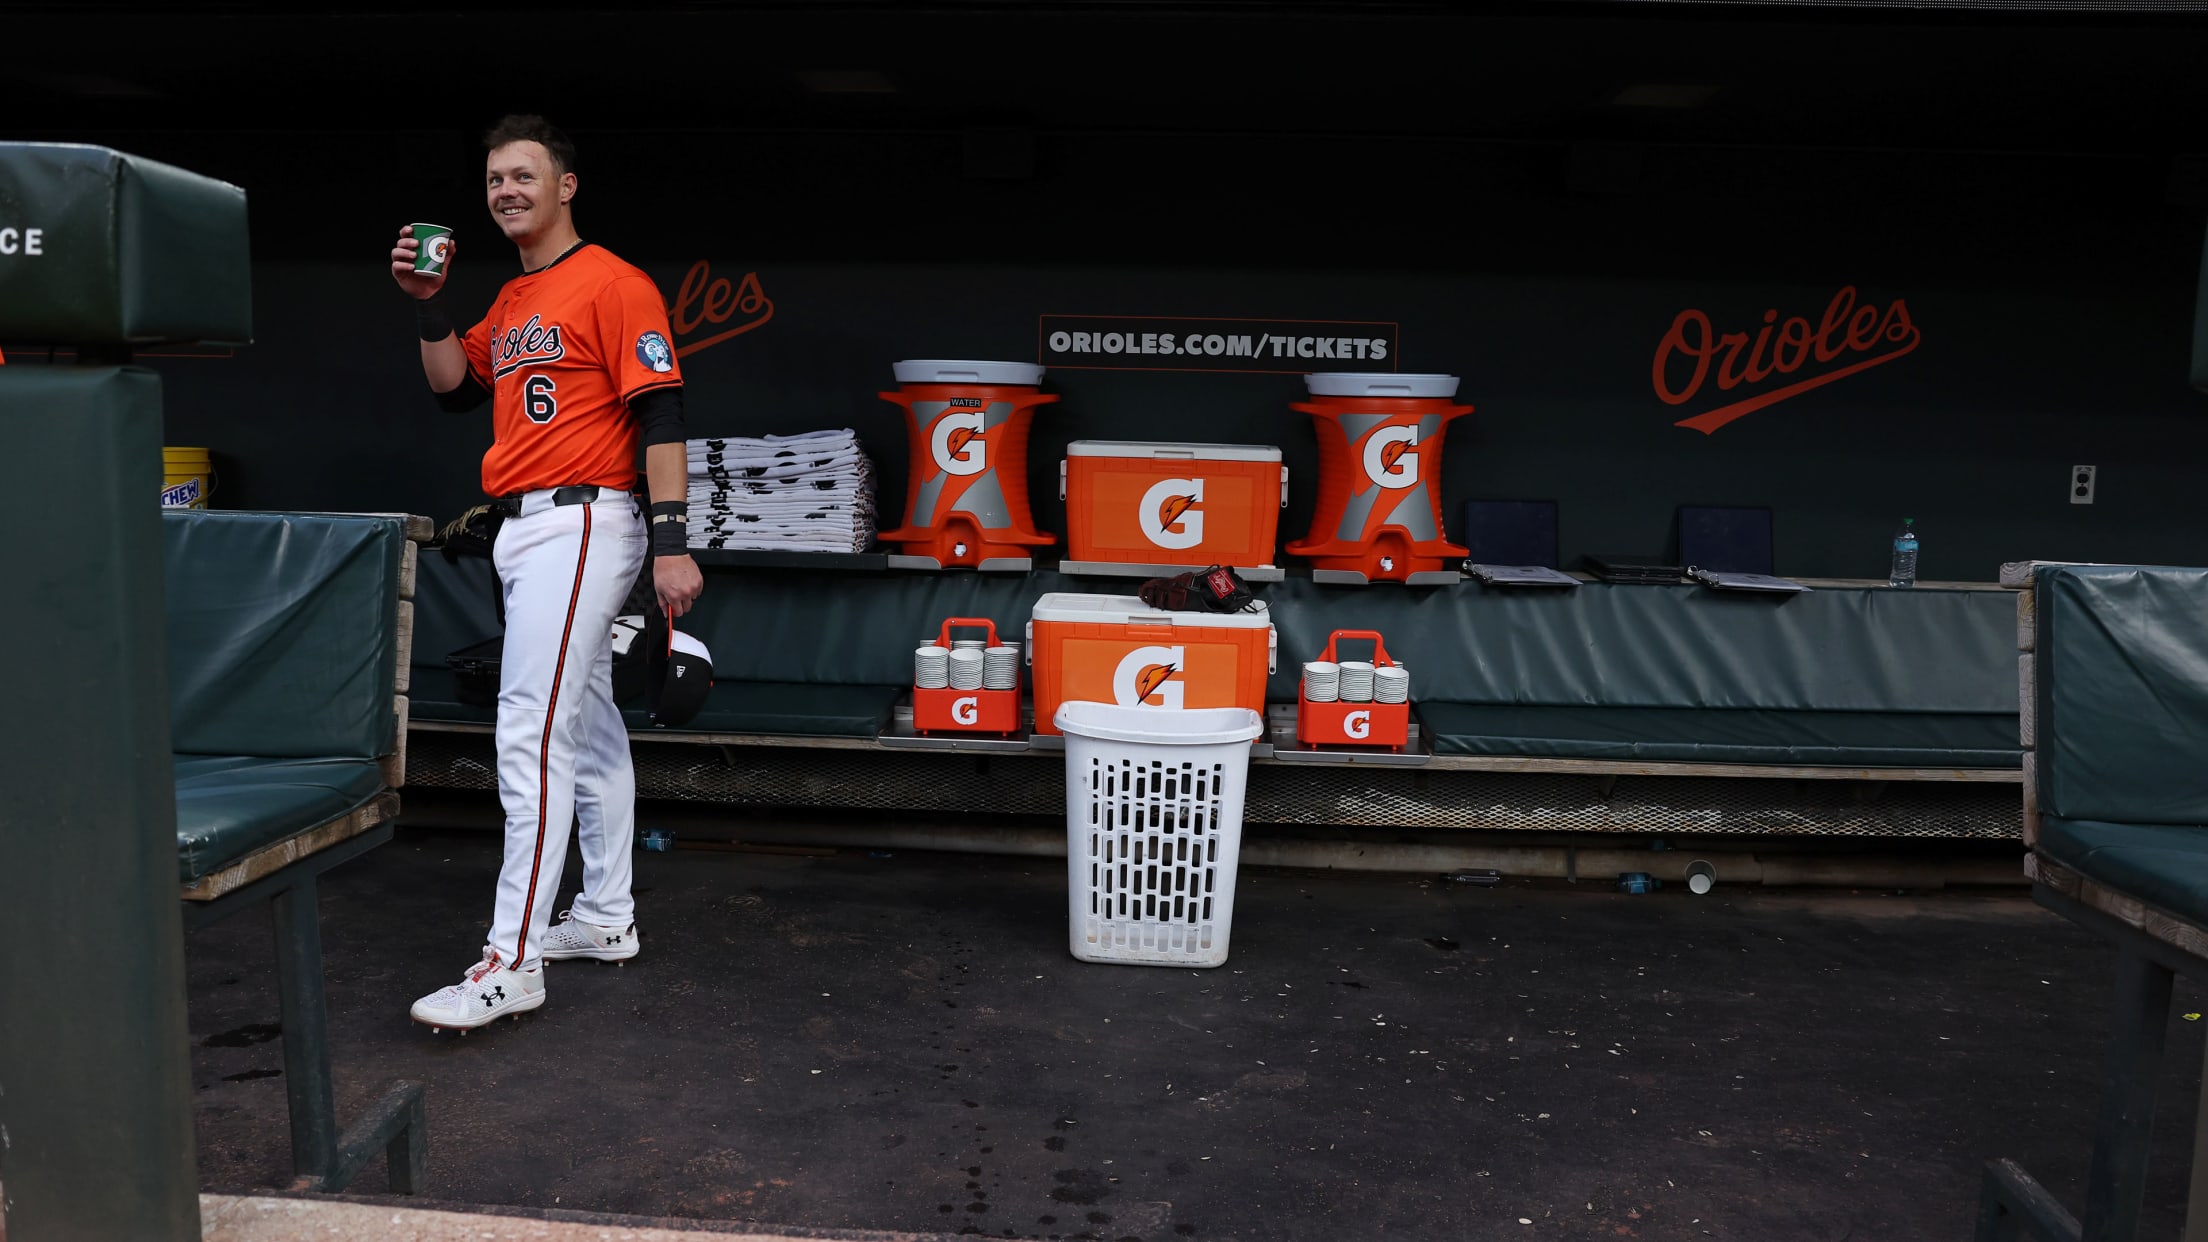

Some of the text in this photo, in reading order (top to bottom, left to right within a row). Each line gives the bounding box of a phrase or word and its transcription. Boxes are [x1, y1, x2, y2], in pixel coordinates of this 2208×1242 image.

[1049, 331, 1388, 360] ORIOLES.COM/TICKETS
[1652, 285, 1920, 428] Orioles
[524, 375, 557, 424] 6
[951, 398, 981, 407] WATER
[931, 411, 987, 476] G
[1362, 423, 1419, 489] G
[160, 478, 200, 506] CHEW
[1138, 478, 1205, 550] G
[1112, 645, 1185, 709] G
[951, 696, 978, 725] G
[1343, 710, 1371, 739] G
